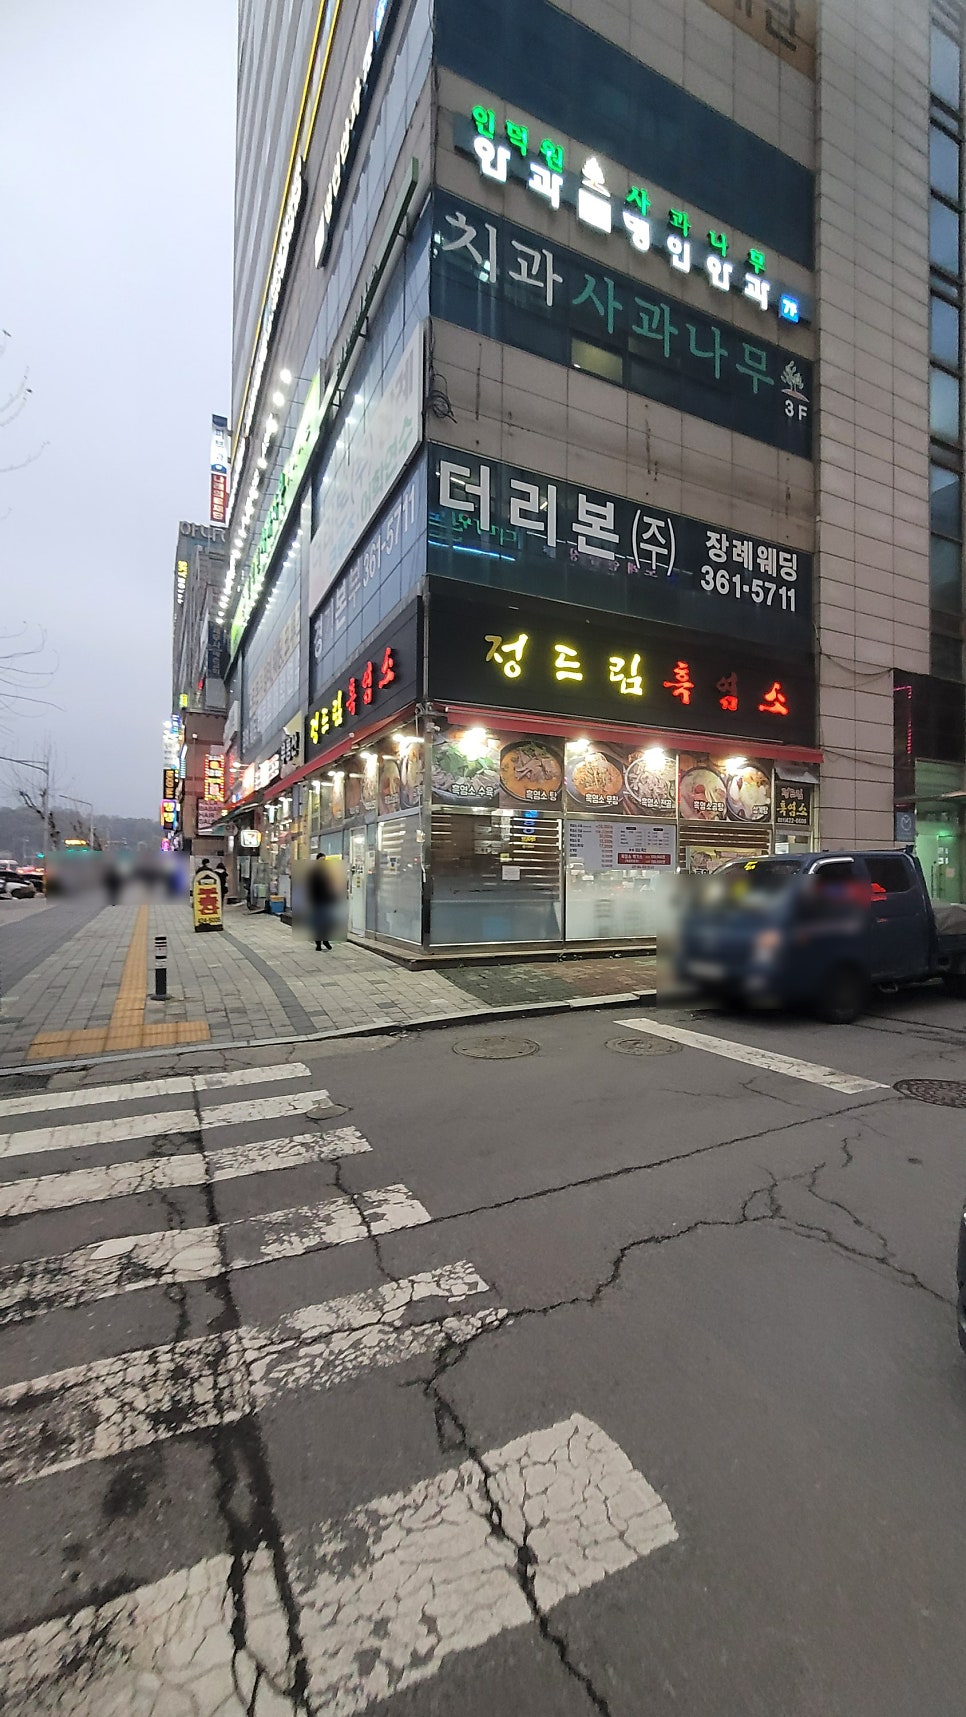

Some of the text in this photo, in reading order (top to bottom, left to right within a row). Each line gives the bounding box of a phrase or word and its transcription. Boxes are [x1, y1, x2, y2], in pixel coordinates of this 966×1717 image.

[472, 105, 564, 174] 인덕원
[473, 136, 564, 210] 안과
[622, 210, 770, 311] 명인안과
[626, 185, 766, 274] 사과나무
[442, 211, 775, 394] 치과 사과나무
[785, 400, 807, 420] 3F
[314, 485, 416, 658] 경기본부 361-5711
[705, 530, 798, 582] 장례웨딩
[483, 633, 790, 716] 정드림 흑염소
[451, 784, 476, 796] 흑염소
[776, 800, 808, 817] 흑염소
